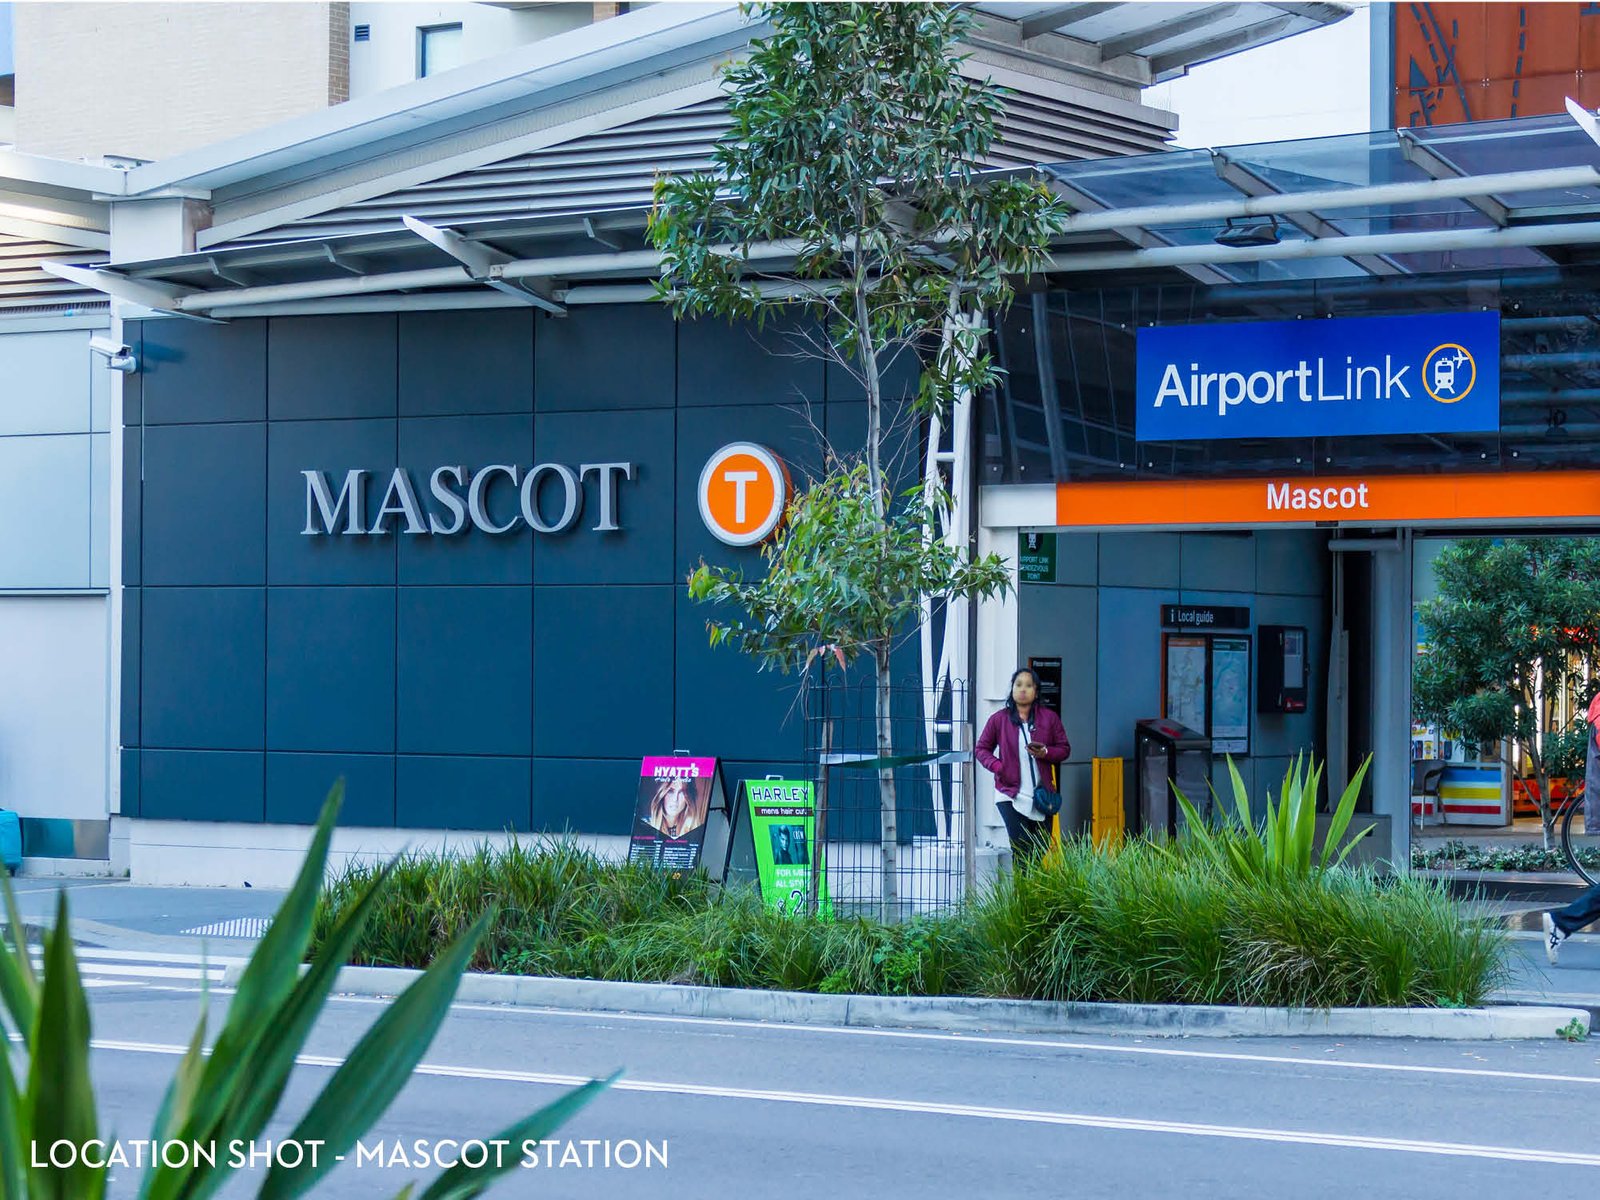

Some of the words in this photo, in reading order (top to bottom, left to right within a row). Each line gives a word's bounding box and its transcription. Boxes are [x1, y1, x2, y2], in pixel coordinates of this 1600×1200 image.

[300, 461, 637, 537] MASCOT
[723, 469, 759, 525] T
[1266, 482, 1370, 511] Mascot
[1178, 609, 1195, 622] Local
[1196, 610, 1214, 625] guide
[751, 787, 809, 802] HARLEY
[761, 807, 780, 815] mens
[781, 807, 793, 815] hair
